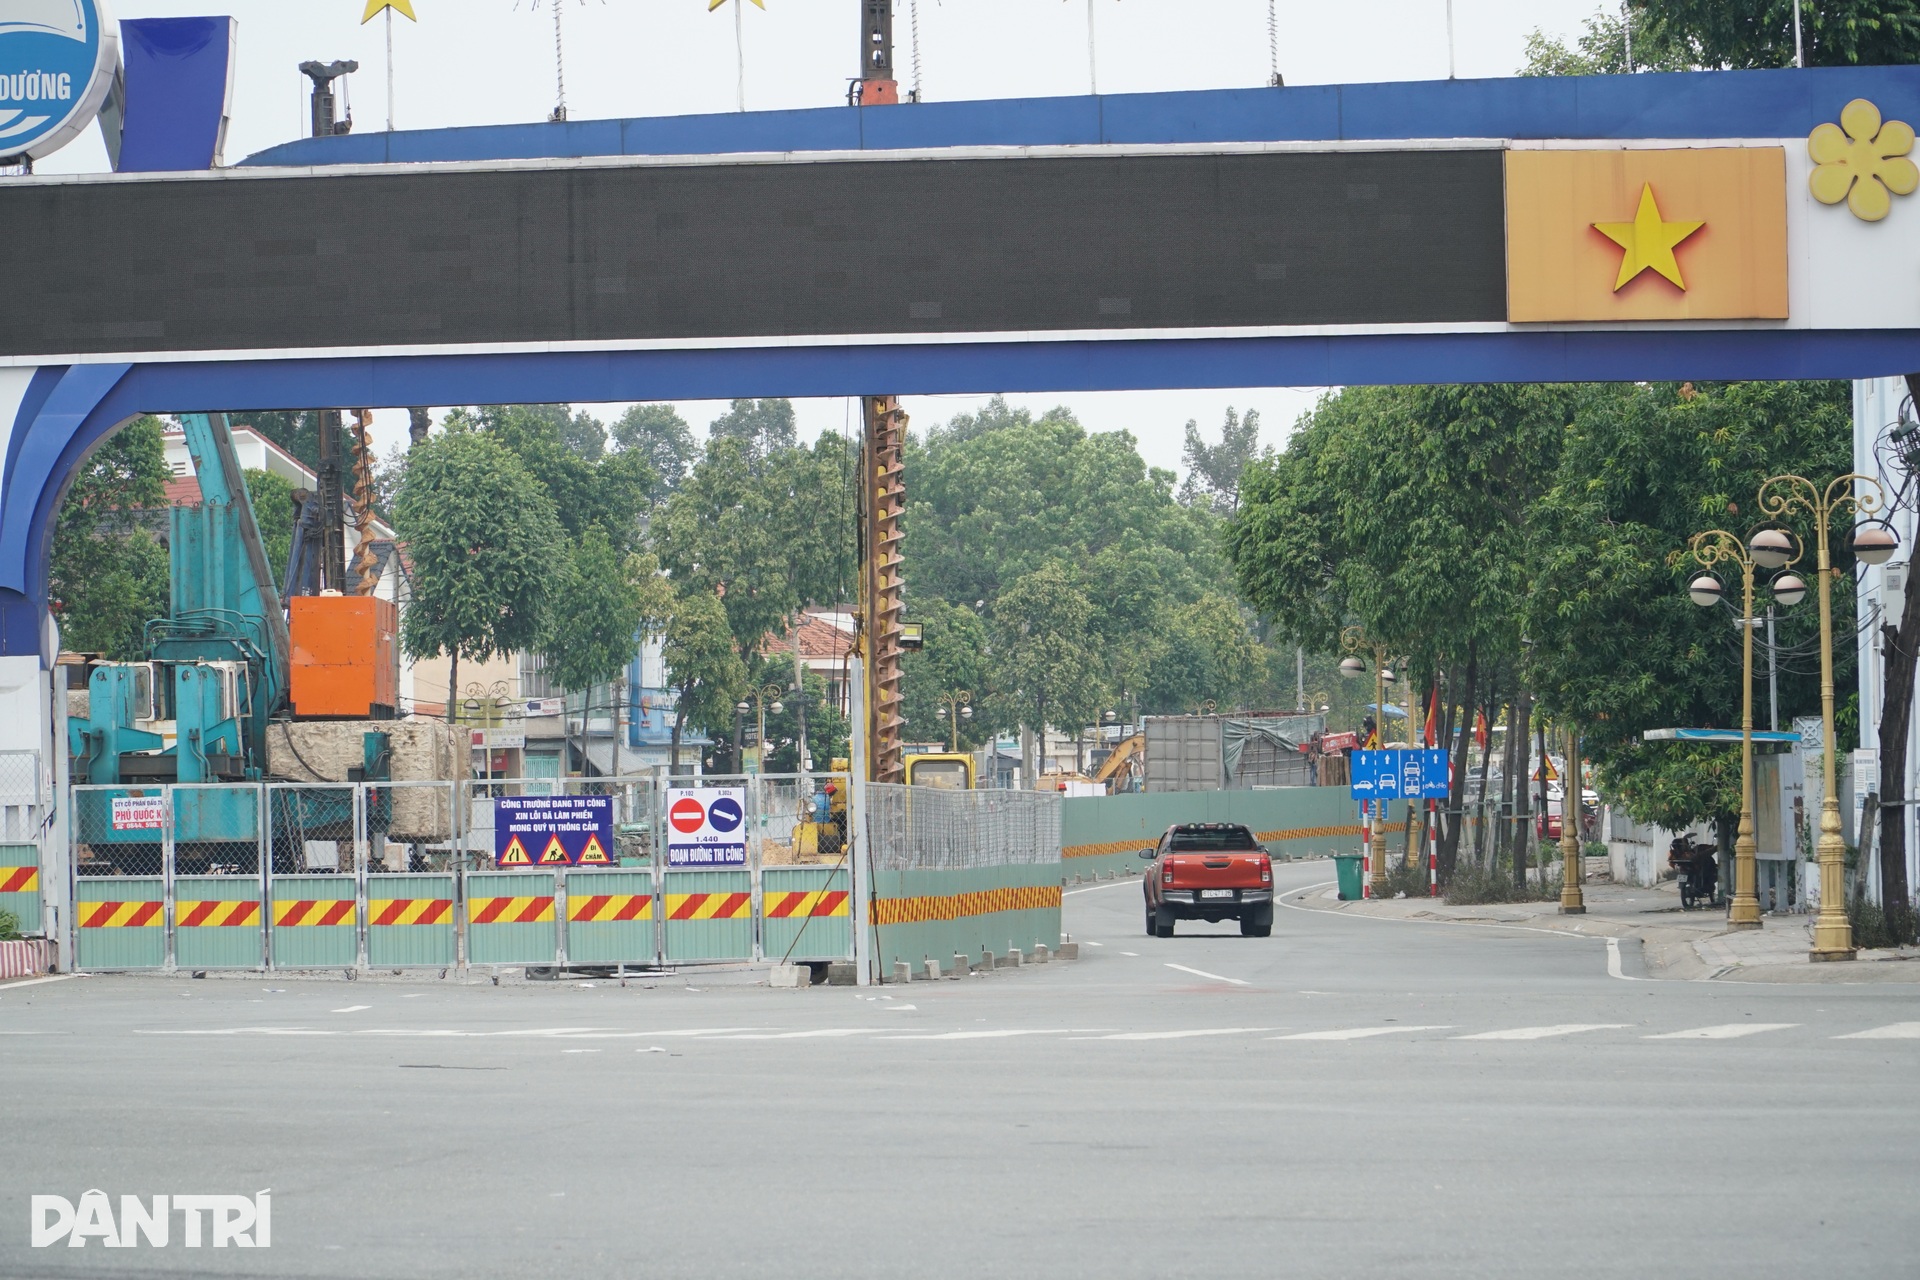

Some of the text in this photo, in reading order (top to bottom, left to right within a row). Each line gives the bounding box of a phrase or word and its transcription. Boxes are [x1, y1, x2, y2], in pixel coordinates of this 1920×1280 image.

[0, 70, 71, 100] DƯƠNG
[501, 799, 521, 808] CÔNG
[522, 799, 551, 808] TRƯỜNG
[552, 800, 572, 808] ĐANG
[586, 798, 606, 807] CÔNG
[134, 808, 154, 820] QUỐC
[515, 812, 528, 820] XIN
[542, 811, 552, 820] ĐÃ
[554, 811, 569, 819] LÀM
[509, 824, 531, 832] MONG
[557, 822, 580, 831] THÔNG
[582, 821, 599, 831] CẢM
[670, 845, 743, 865] ĐOẠN ĐƯỜNG THI CÔNG
